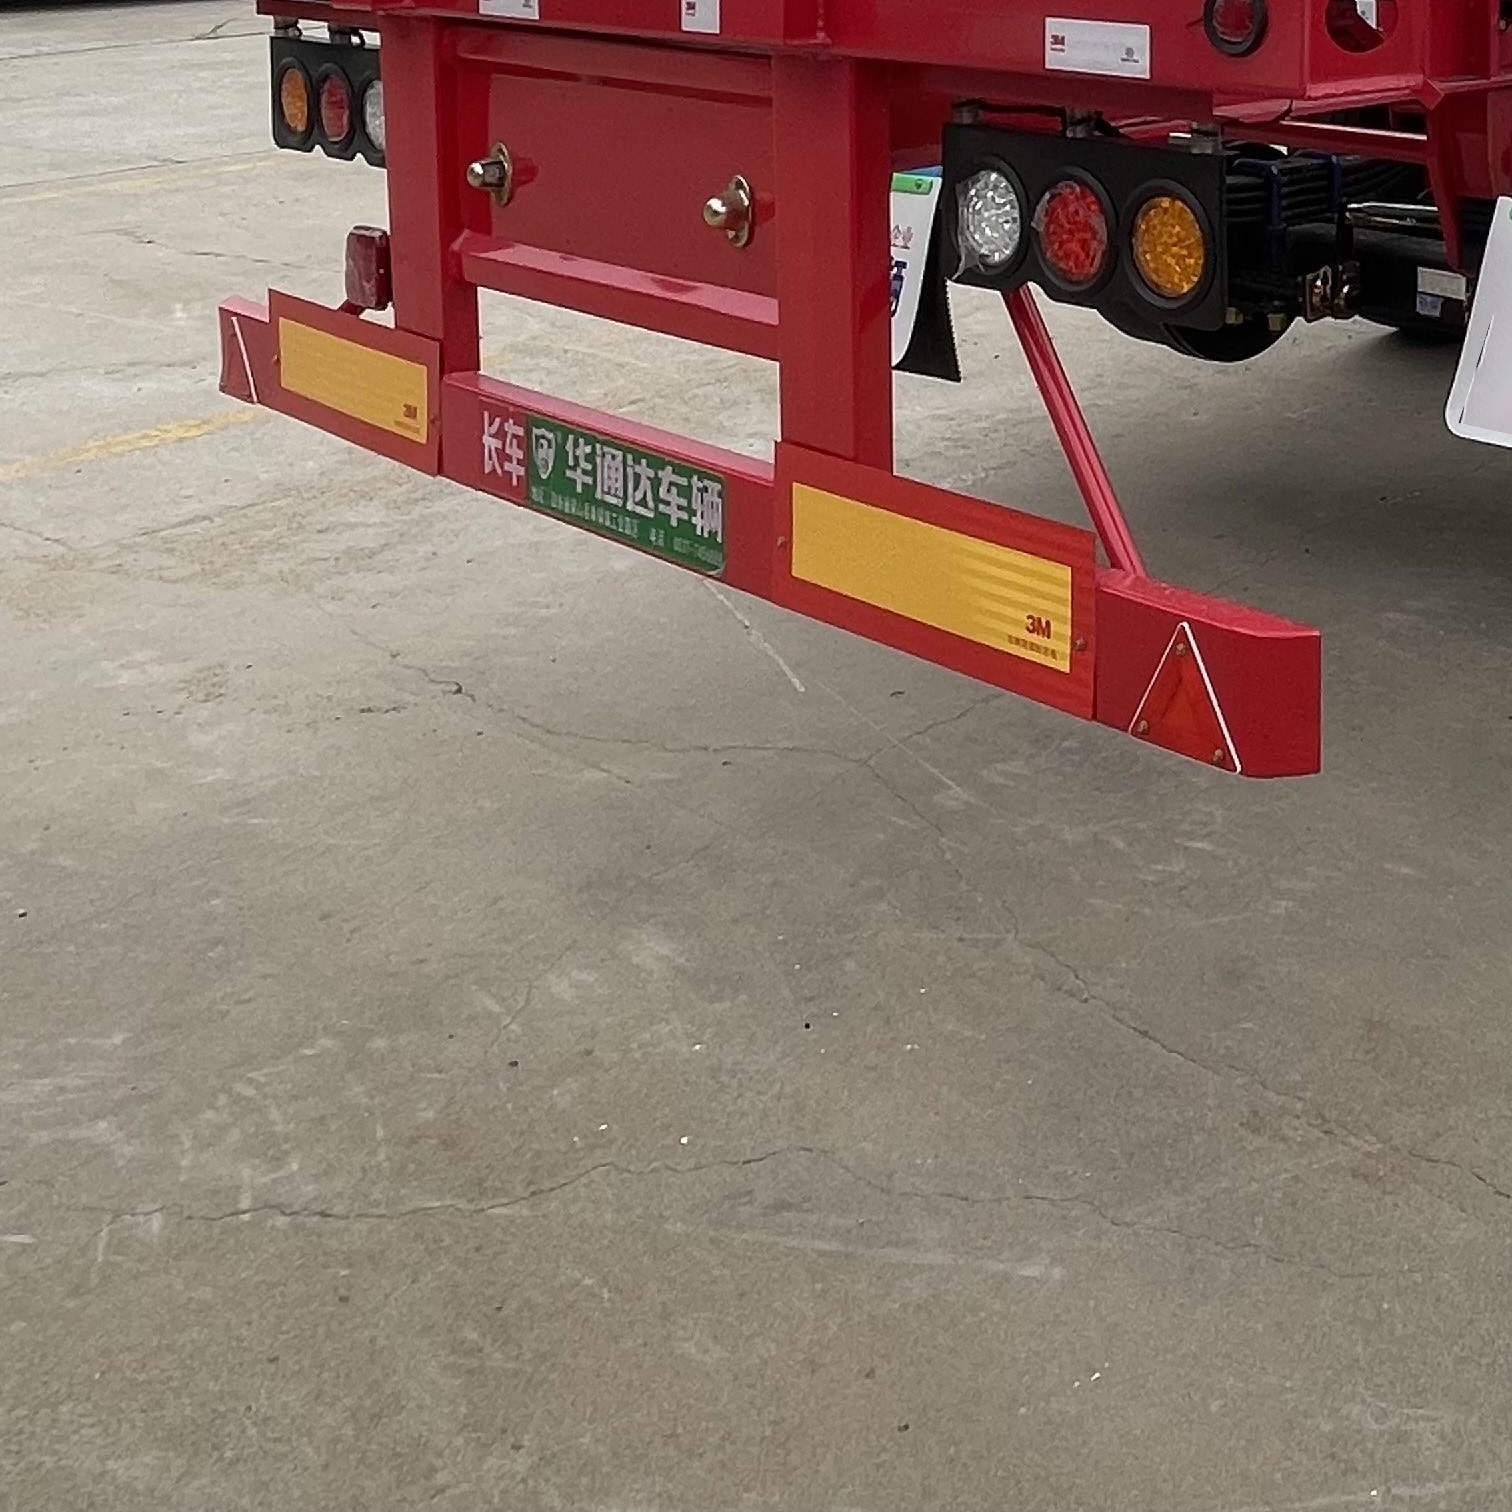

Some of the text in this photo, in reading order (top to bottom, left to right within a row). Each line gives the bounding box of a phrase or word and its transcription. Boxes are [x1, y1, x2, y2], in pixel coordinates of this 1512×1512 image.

[482, 410, 526, 487] 长车
[564, 434, 723, 544] 华通达车辆
[1024, 614, 1052, 640] 3M
